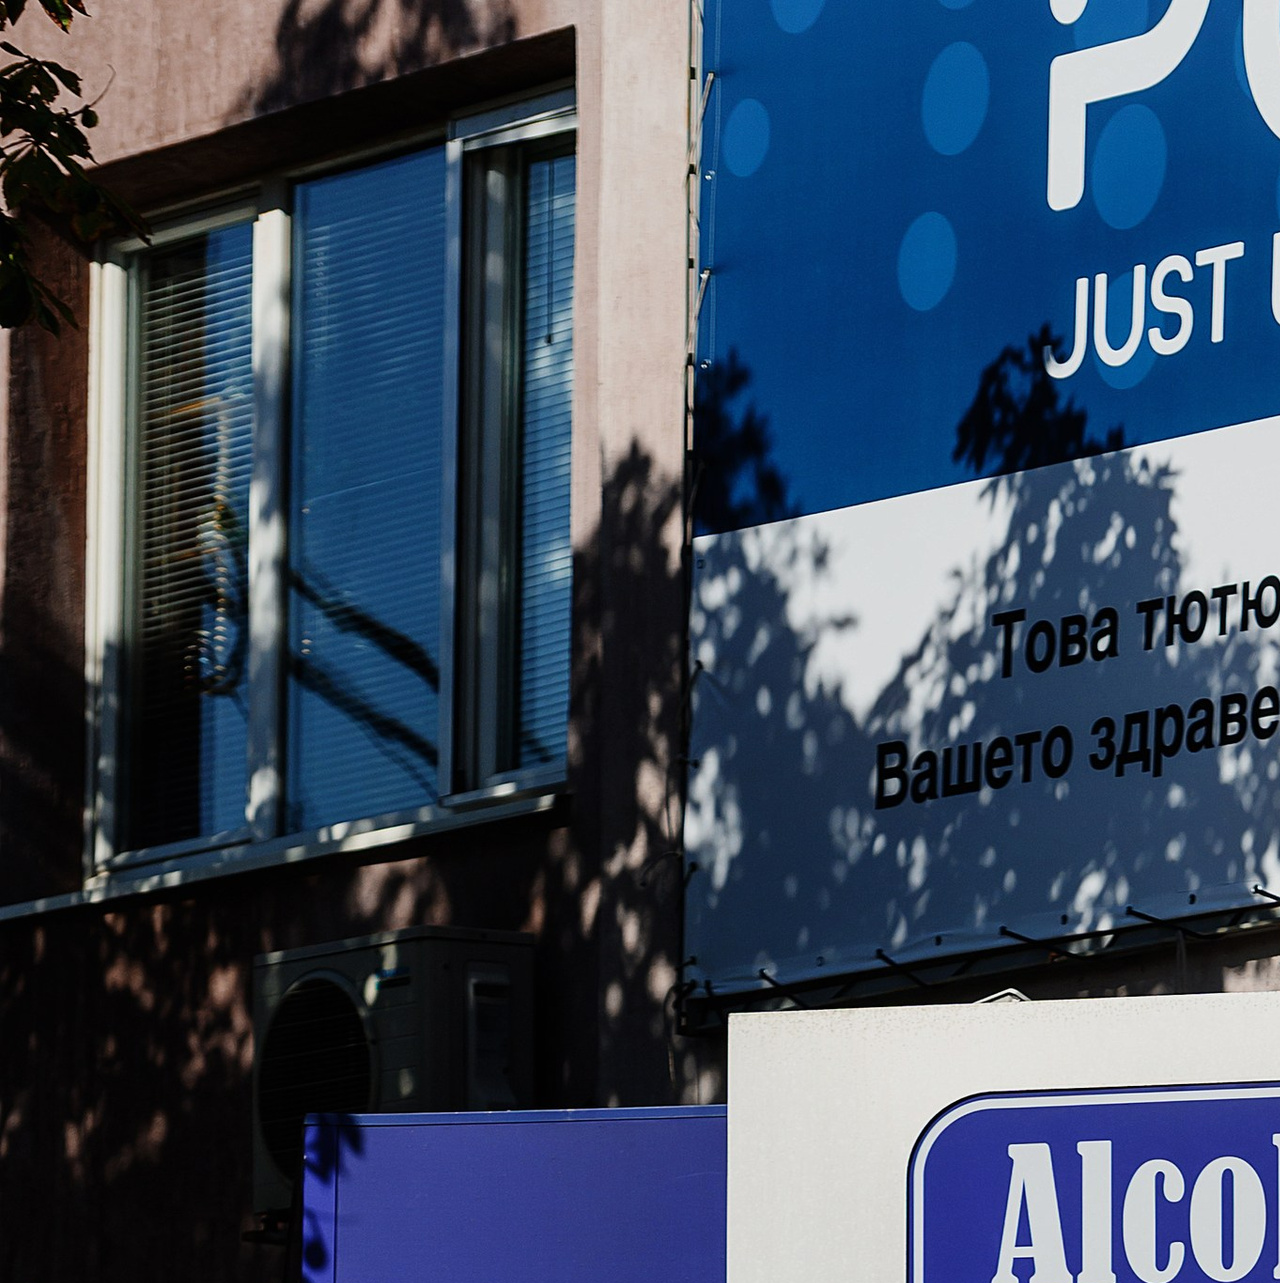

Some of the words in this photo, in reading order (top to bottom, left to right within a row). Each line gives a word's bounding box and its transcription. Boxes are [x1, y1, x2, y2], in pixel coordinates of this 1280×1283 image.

[1045, 242, 1245, 379] JUST
[992, 606, 1120, 680] Това
[873, 724, 1075, 819] Вашето
[1087, 685, 1280, 779] здраве
